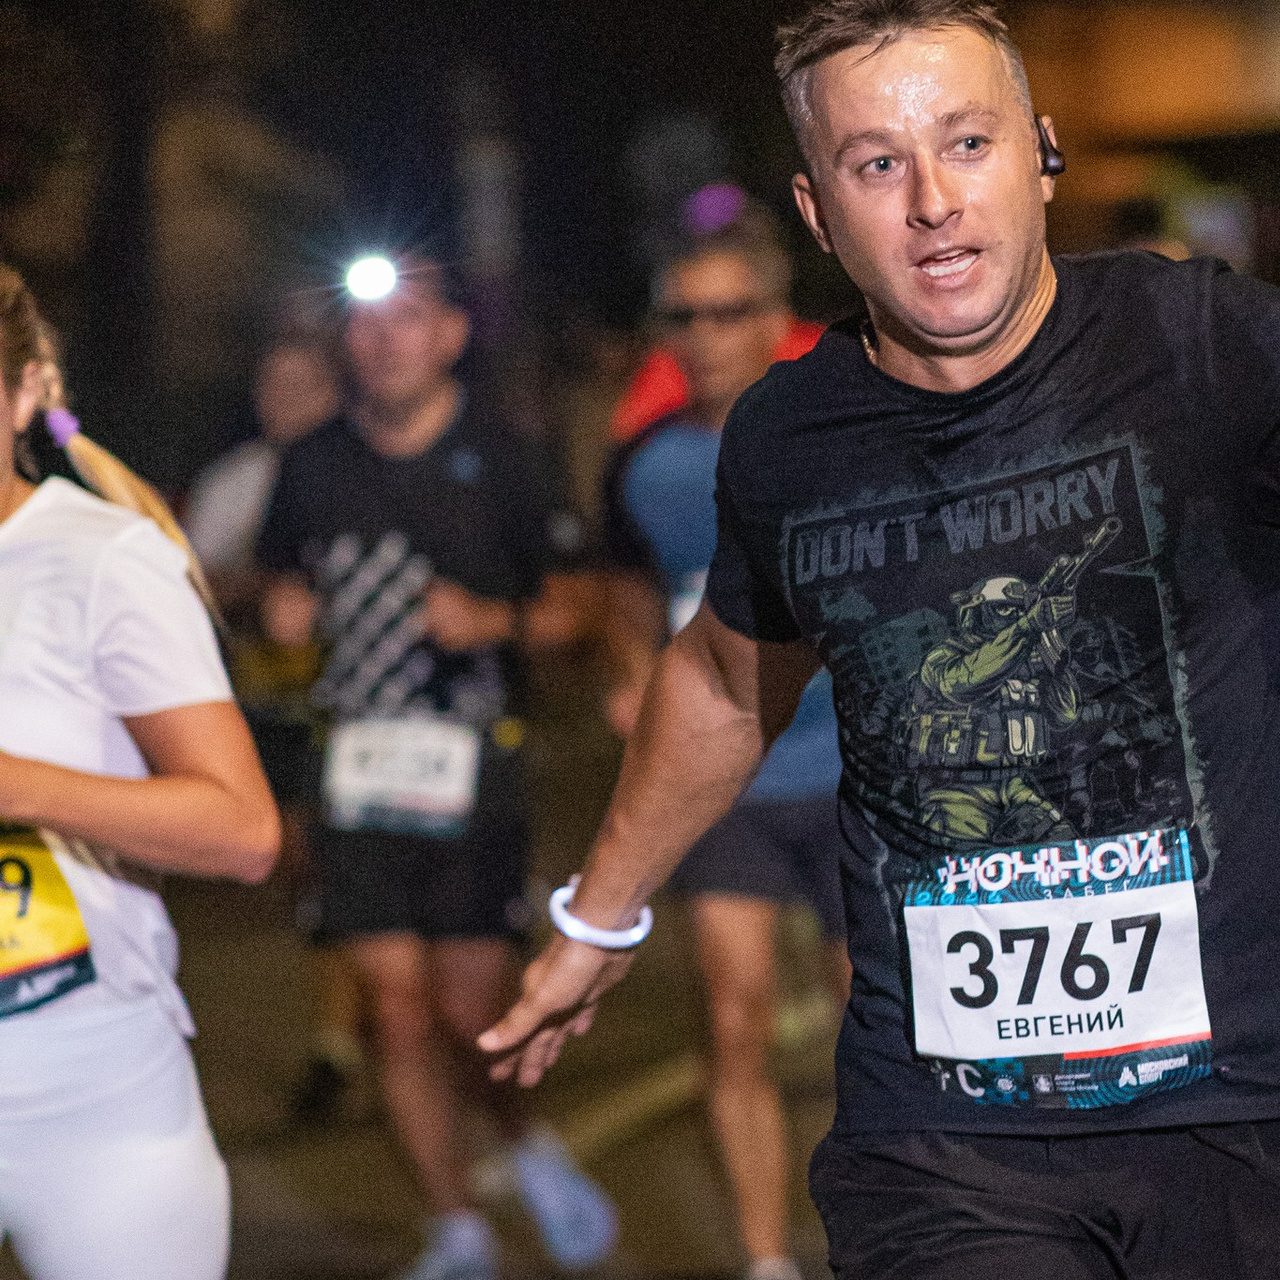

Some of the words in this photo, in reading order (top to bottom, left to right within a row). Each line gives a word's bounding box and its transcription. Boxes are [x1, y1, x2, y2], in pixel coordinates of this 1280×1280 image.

[796, 511, 926, 585] DON'T
[939, 458, 1119, 554] WORRY
[946, 912, 1162, 1009] 3767
[997, 1003, 1124, 1040] ЕВГЕНИЙ
